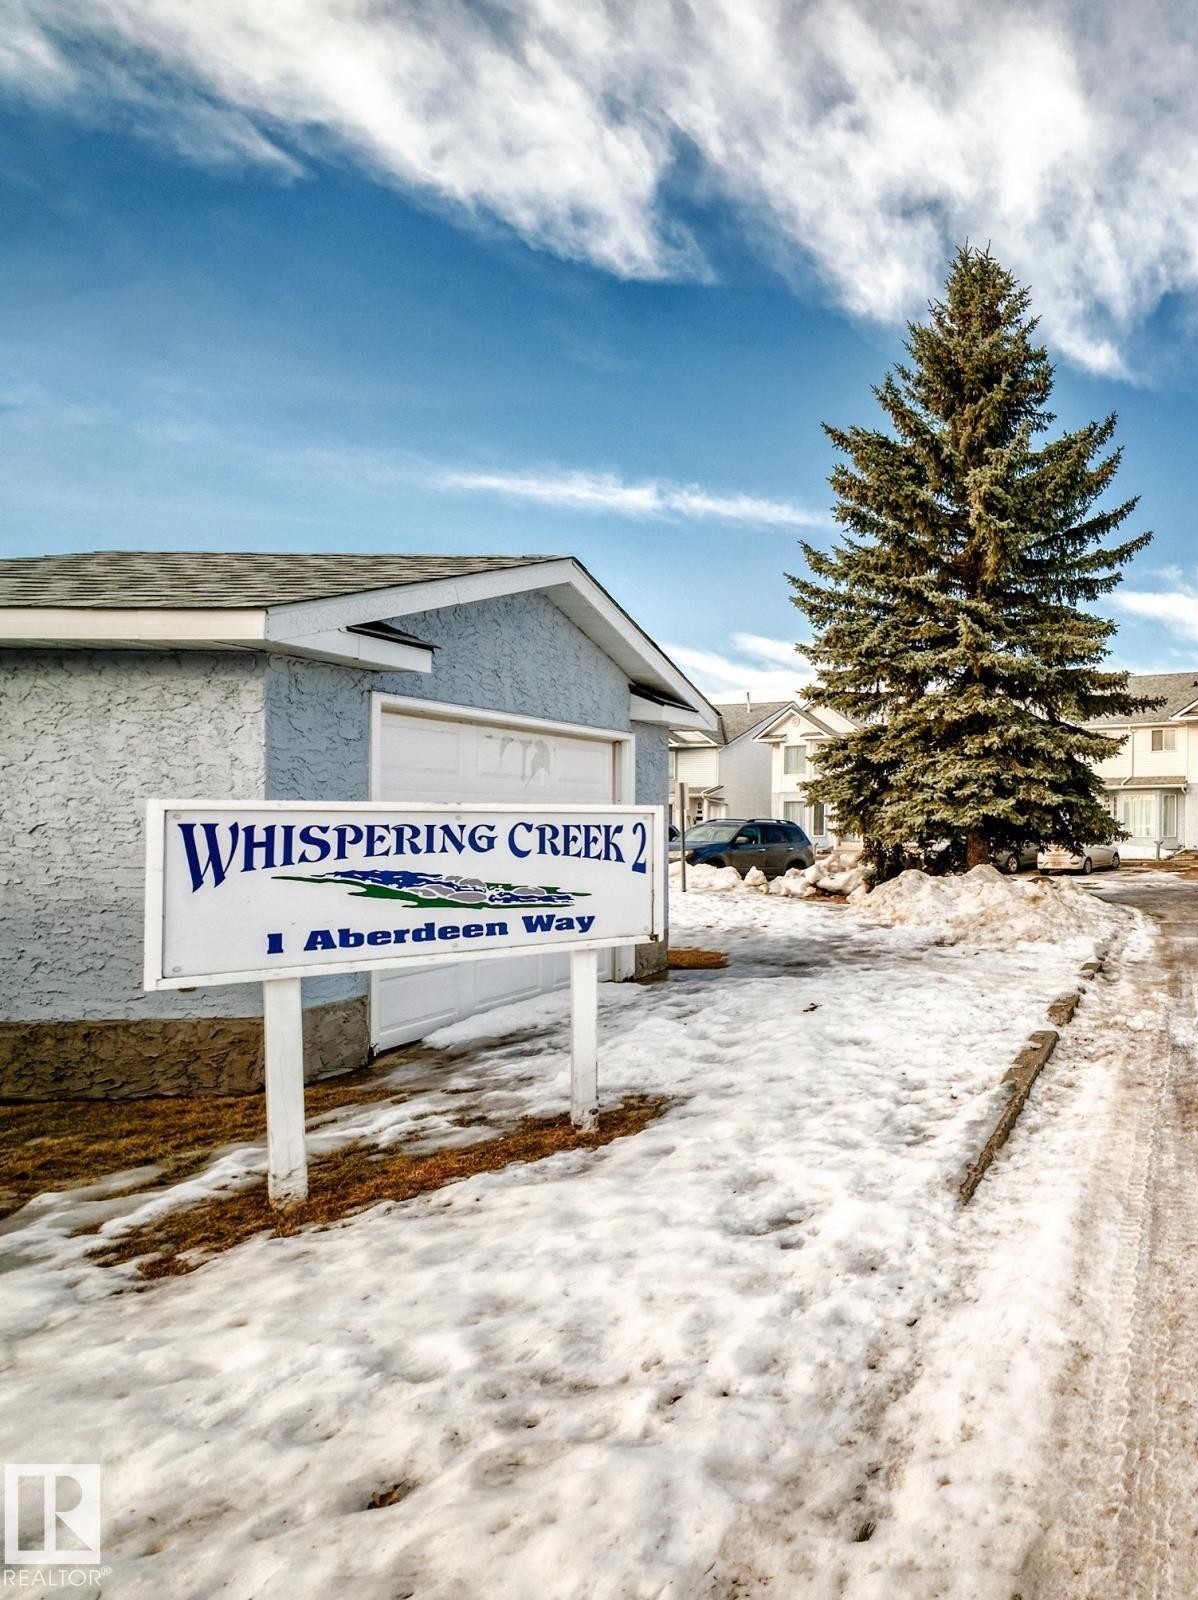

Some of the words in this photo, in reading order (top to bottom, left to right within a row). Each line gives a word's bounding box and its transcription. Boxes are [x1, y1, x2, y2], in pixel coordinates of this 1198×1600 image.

[177, 821, 498, 893] WHISPERING
[507, 821, 626, 863] CREEK
[631, 822, 647, 874] 2
[303, 920, 509, 951] Aberdeen
[521, 914, 596, 934] Way
